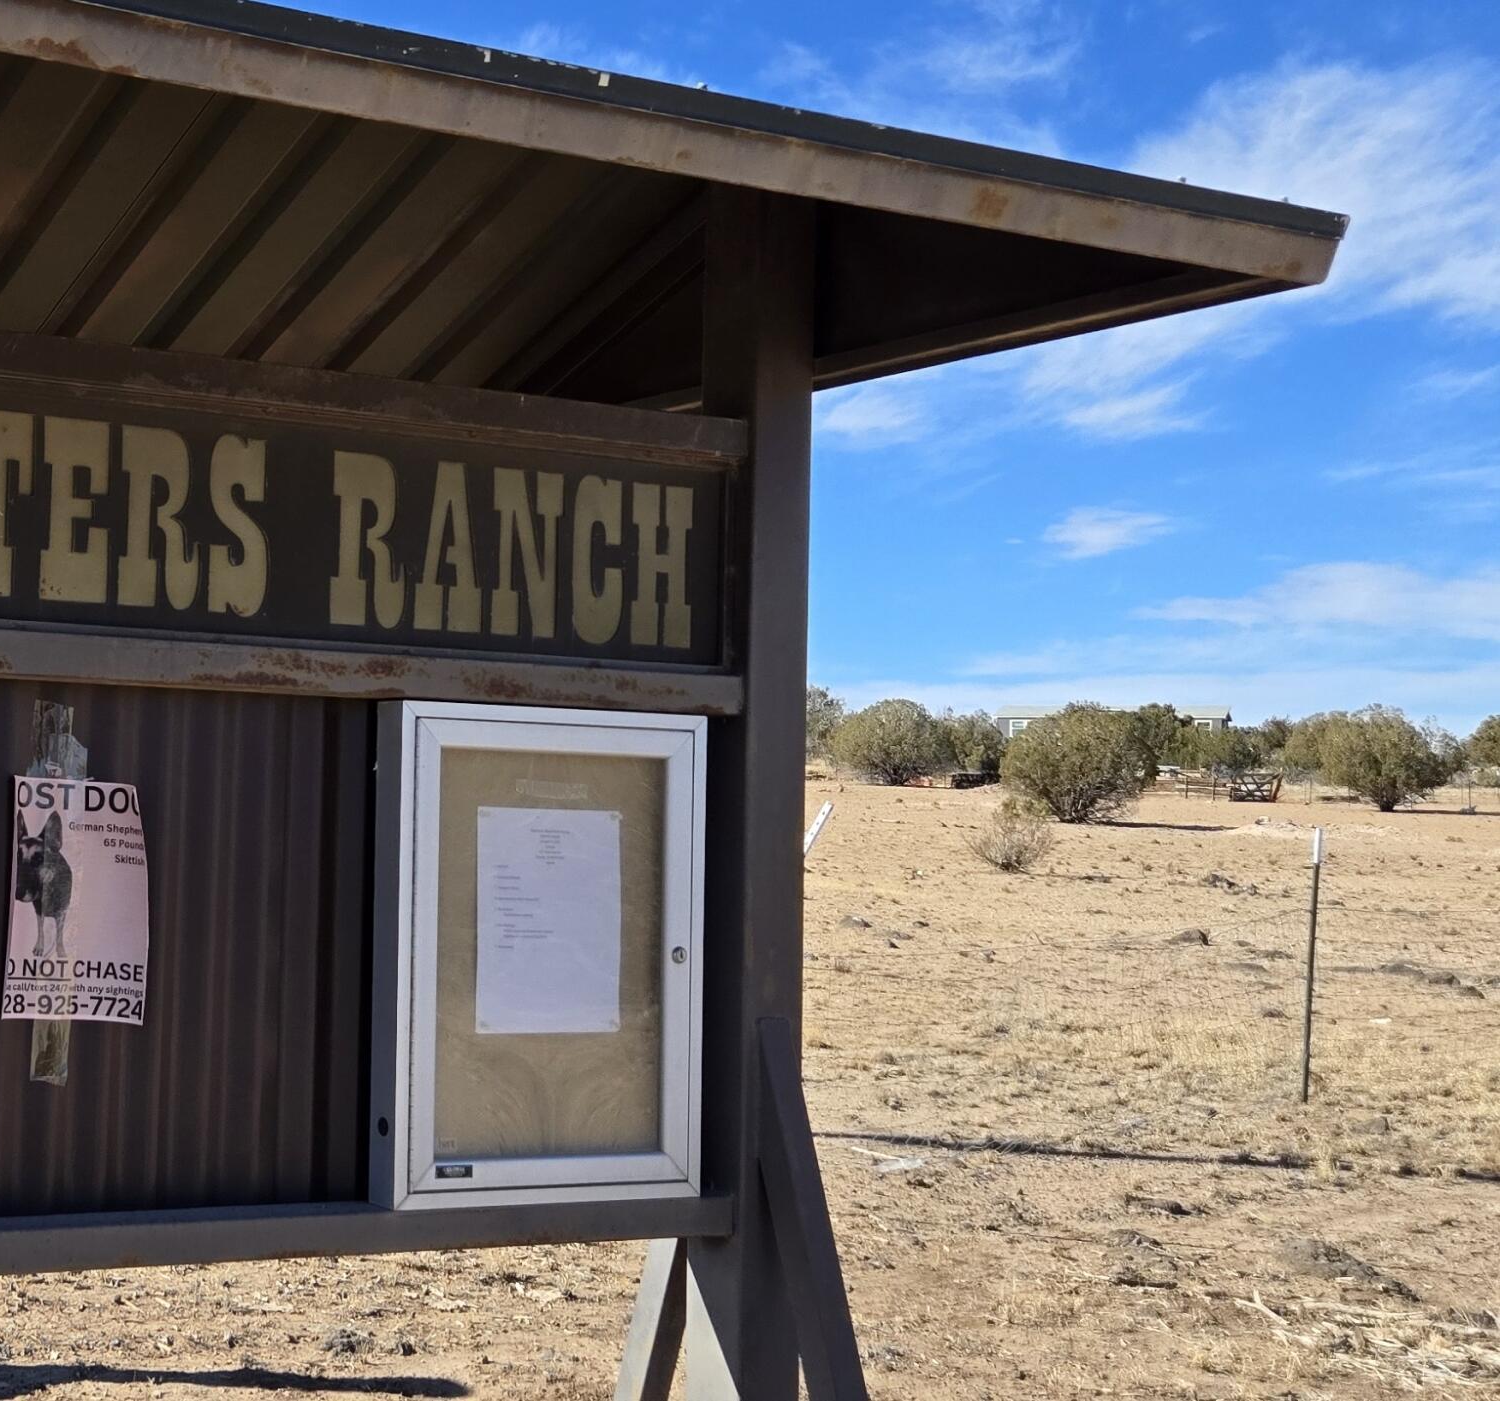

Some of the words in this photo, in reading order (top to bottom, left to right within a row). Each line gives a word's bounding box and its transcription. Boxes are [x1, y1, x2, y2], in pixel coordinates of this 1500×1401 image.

[329, 450, 694, 649] RANCH
[17, 780, 76, 811] OST
[68, 821, 104, 833] German
[107, 824, 143, 837] Shepher
[103, 838, 116, 848] 65
[114, 854, 146, 866] Skittish
[21, 958, 69, 978] NOT
[72, 959, 145, 983] CHASE
[87, 985, 104, 995] any
[105, 984, 144, 999] sightings
[2, 993, 144, 1021] 28-925-7724
